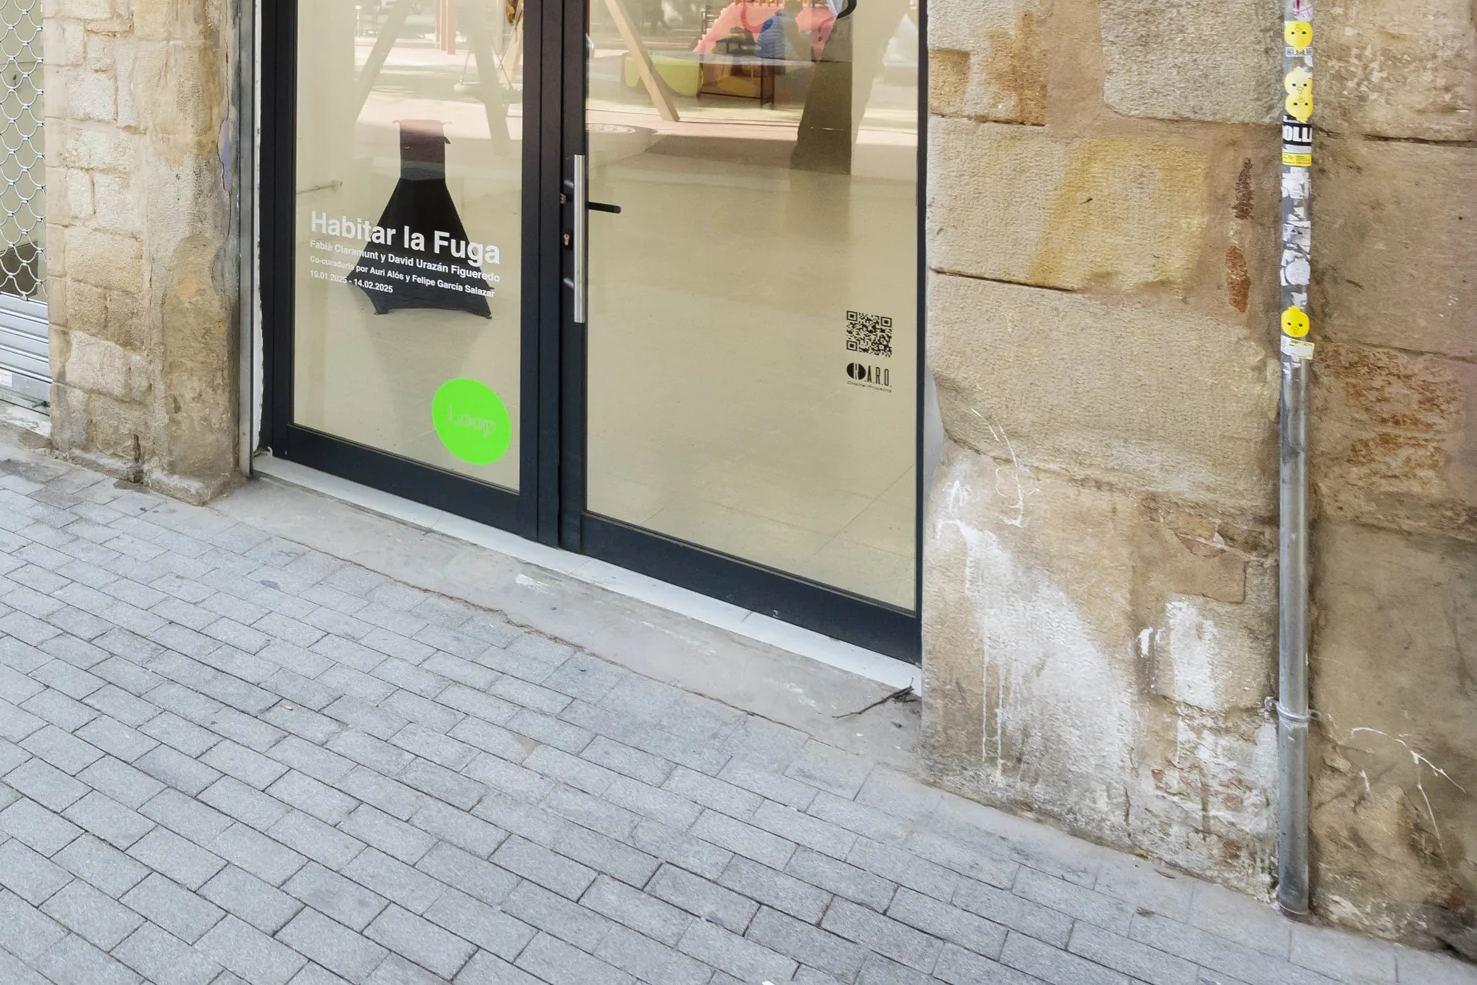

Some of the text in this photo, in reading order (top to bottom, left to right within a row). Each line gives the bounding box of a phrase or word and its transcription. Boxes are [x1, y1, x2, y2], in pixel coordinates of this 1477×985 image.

[311, 210, 500, 268] Habitar la Fuga
[310, 239, 501, 283] Fabià Claramunt y David Urazán Figueredo
[310, 270, 348, 284] 10.01.2025
[353, 278, 394, 293] 14.02.2025
[356, 265, 368, 273] por
[370, 267, 385, 276] Auri
[387, 270, 404, 281] Alós
[405, 274, 410, 283] y
[412, 274, 436, 286] Felipe
[437, 280, 463, 292] García
[464, 285, 495, 297] Salazar
[447, 405, 497, 439] Loop
